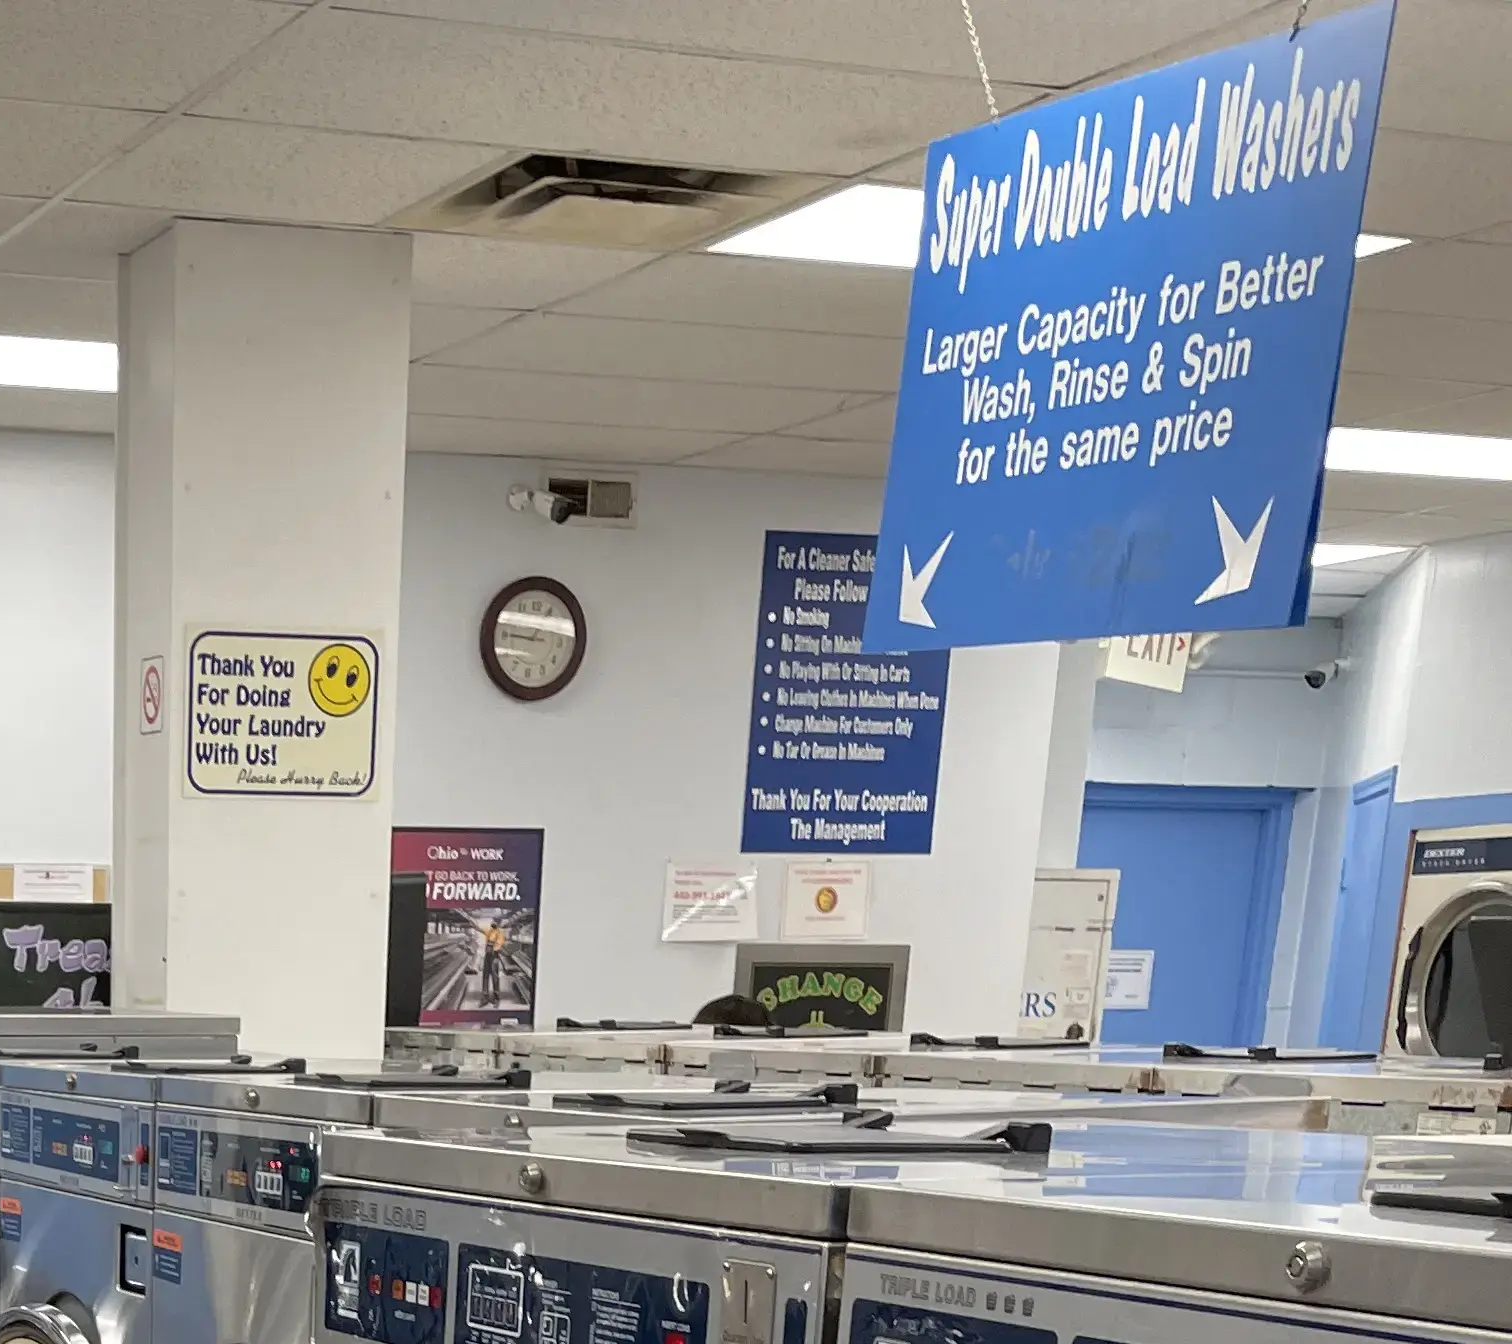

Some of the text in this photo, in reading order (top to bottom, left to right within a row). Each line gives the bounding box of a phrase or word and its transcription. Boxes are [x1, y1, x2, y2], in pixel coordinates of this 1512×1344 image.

[930, 47, 1361, 294] Super Double Load Washers
[921, 252, 1325, 378] Larger Capacity for Better
[962, 333, 1253, 426] Wash, Rinse & Spin
[956, 401, 1234, 485] for the same price
[777, 545, 796, 570] For
[797, 547, 807, 571] A
[808, 547, 851, 572] Cleaner
[794, 577, 869, 602] Please Follow
[197, 653, 294, 678] Thank You
[197, 684, 291, 708] For Doing
[196, 713, 326, 738] Your Laundry
[195, 742, 278, 766] With Us!
[237, 768, 276, 785] Please
[751, 787, 928, 816] Thank You For Your Cooperation
[790, 817, 885, 846] The Management
[427, 845, 459, 860] Ohio
[470, 847, 504, 860] WORK
[432, 882, 521, 901] FORWARD.
[756, 971, 883, 1016] CHANGE
[1018, 991, 1057, 1018] RS
[383, 1205, 426, 1231] LOAD
[880, 1273, 977, 1308] TRIPLE LOAD
